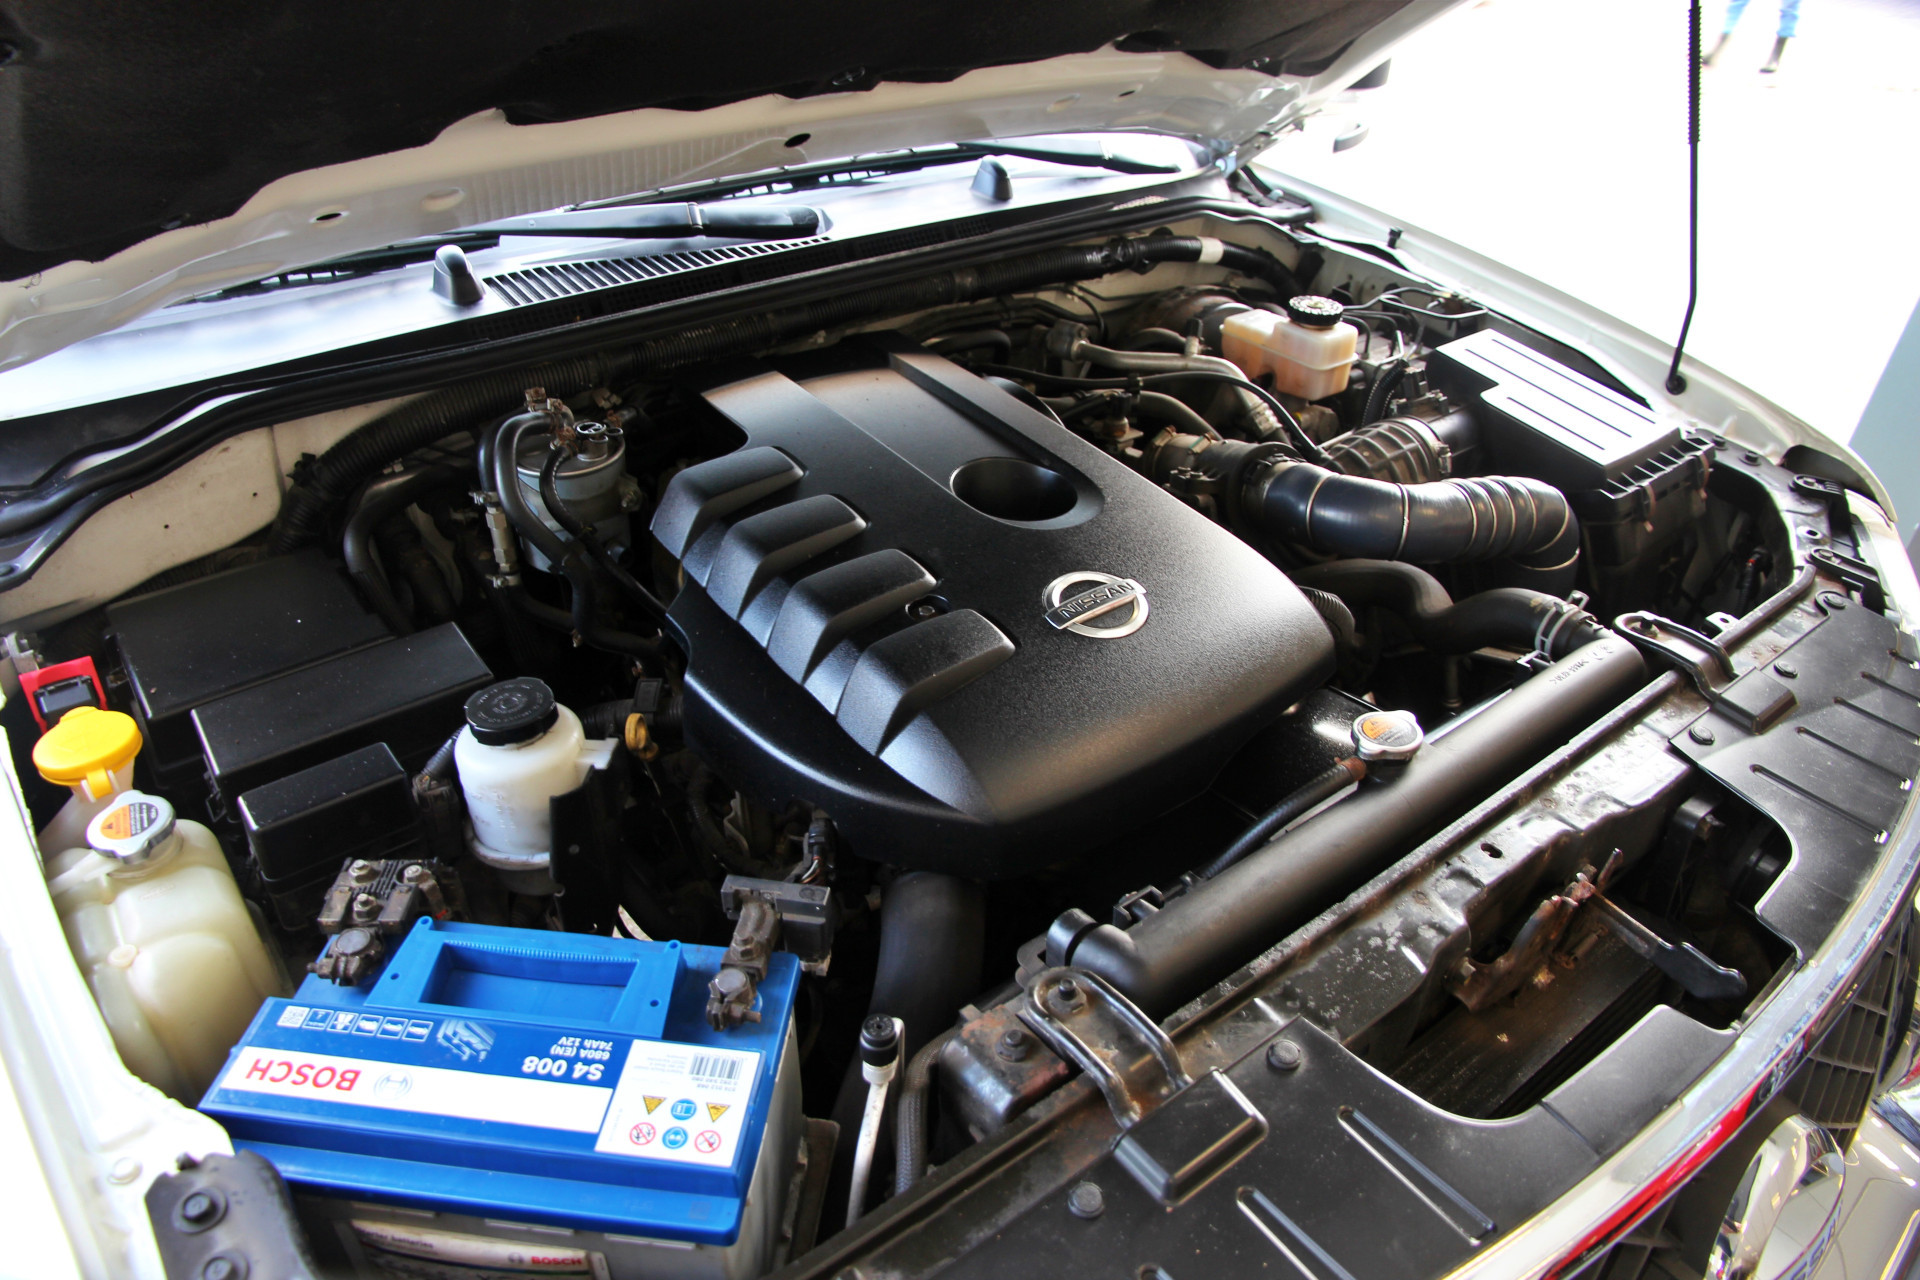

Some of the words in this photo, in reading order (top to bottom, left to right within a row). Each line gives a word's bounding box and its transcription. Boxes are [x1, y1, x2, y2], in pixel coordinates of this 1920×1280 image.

[1058, 582, 1135, 619] NISSAN
[558, 1036, 582, 1047] 12V
[583, 1038, 613, 1051] 74Ah
[550, 1043, 578, 1057] (EN)
[580, 1048, 611, 1061] 680A
[521, 1055, 568, 1077] 008
[572, 1061, 605, 1081] S4
[245, 1058, 362, 1092] BOSCH
[531, 1255, 583, 1266] BOSCH
